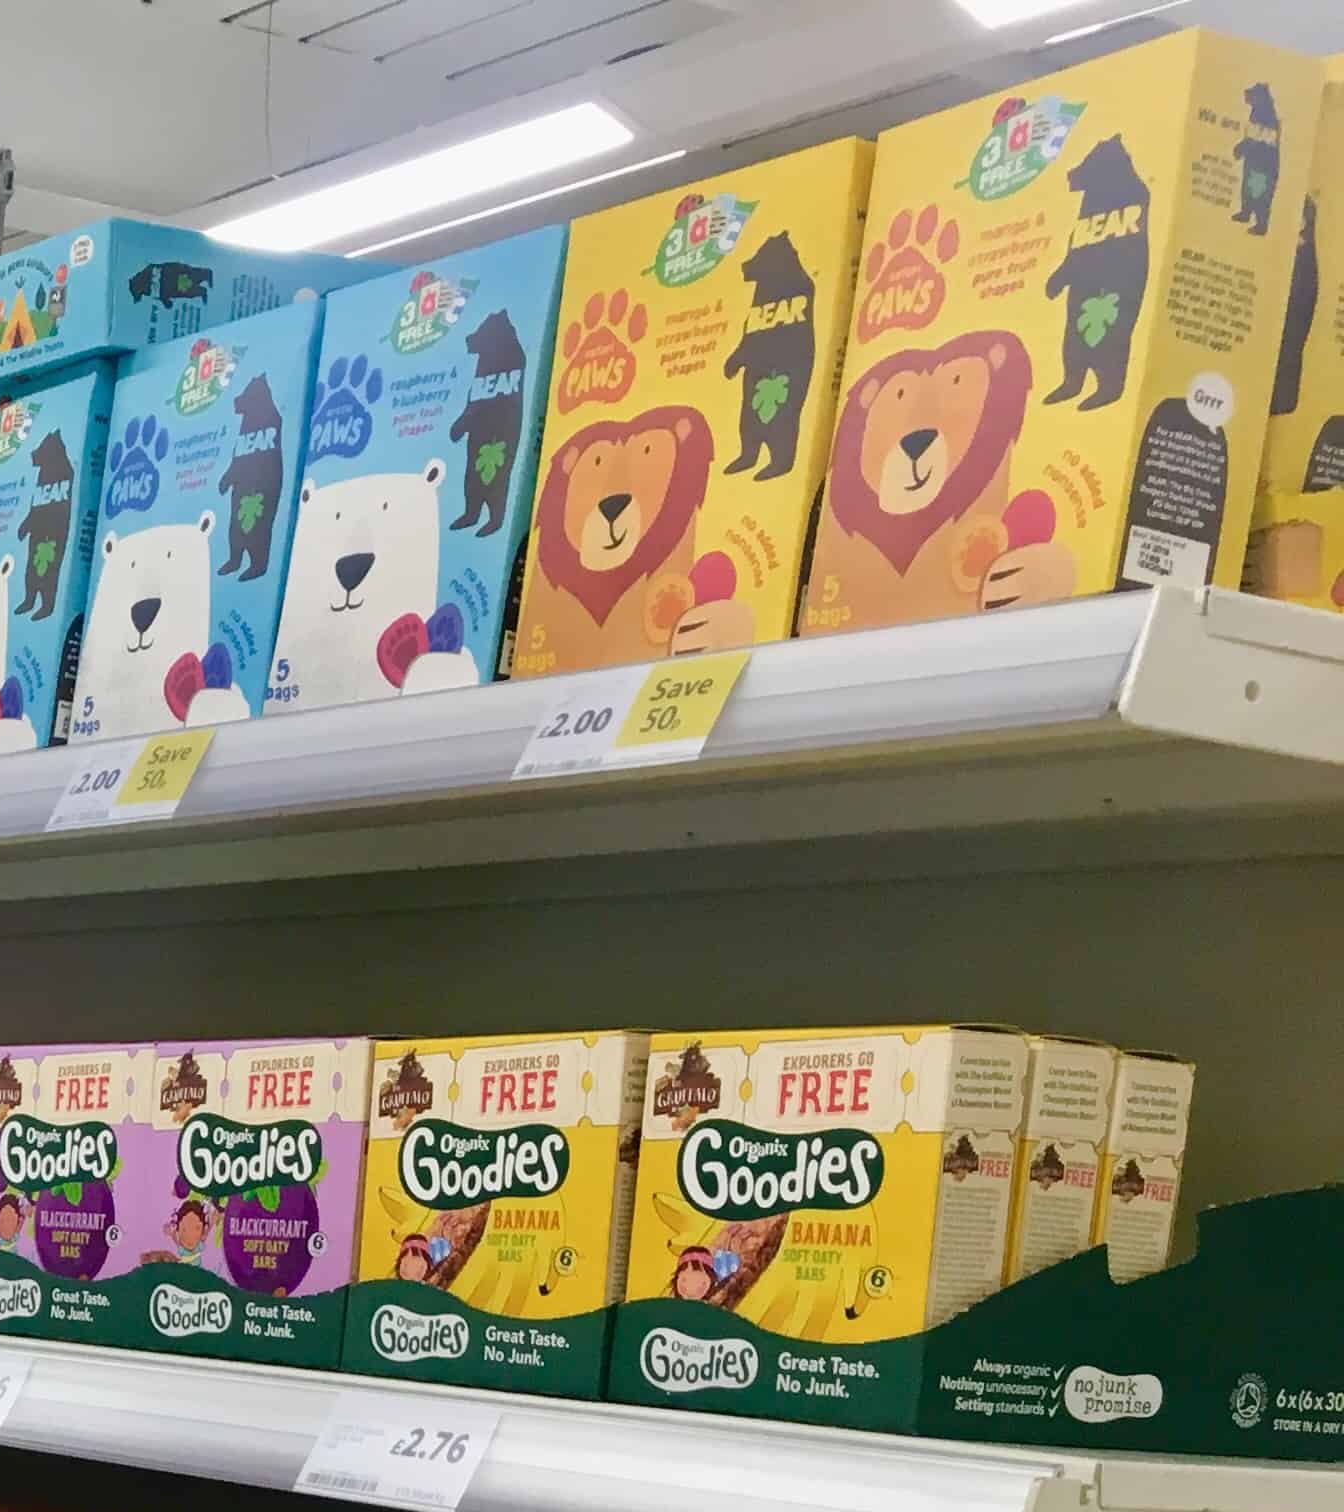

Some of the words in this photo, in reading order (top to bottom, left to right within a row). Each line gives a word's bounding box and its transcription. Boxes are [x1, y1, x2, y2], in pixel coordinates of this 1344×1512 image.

[982, 137, 1001, 168] 3
[1071, 204, 1142, 249] BEAR
[665, 229, 683, 257] 3
[400, 301, 416, 328] 3
[745, 295, 808, 334] BEAR
[866, 280, 934, 325] PAWS
[470, 369, 521, 402] BEAR
[566, 358, 626, 398] PAWS
[1194, 389, 1224, 410] Grrr
[233, 427, 276, 457] BEAR
[313, 417, 363, 452] PAWS
[1061, 449, 1081, 468] no
[31, 479, 70, 506] BEAR
[112, 472, 153, 506] PAWS
[823, 576, 840, 602] 5
[806, 606, 852, 627] bags
[531, 626, 545, 651] 5
[276, 658, 290, 682] 5
[266, 683, 300, 700] bags
[648, 675, 714, 701] Save
[82, 697, 94, 718] 5
[640, 705, 681, 733] 50p
[73, 718, 101, 737] bags
[147, 744, 193, 765] Save
[136, 770, 166, 792] 50p
[484, 1057, 542, 1074] EXPLORERS
[546, 1054, 560, 1068] GO
[783, 1052, 853, 1071] EXPLORERS
[858, 1051, 875, 1066] GO
[247, 1071, 313, 1110] FREE
[480, 1070, 558, 1115] FREE
[777, 1068, 873, 1118] FREE
[180, 1120, 317, 1188] Goodies
[729, 1136, 789, 1163] Organix
[402, 1126, 565, 1201] Goodies
[682, 1127, 878, 1210] Goodies
[229, 1216, 308, 1239] BLACKCURRANT
[493, 1209, 561, 1231] BANANA
[312, 1236, 324, 1251] 6
[791, 1222, 873, 1247] BANANA
[783, 1249, 810, 1264] SOFT
[812, 1250, 843, 1266] OATY
[795, 1265, 826, 1281] BARS
[870, 1269, 885, 1289] 6
[485, 1326, 524, 1344] Great
[529, 1329, 570, 1349] Taste.
[484, 1345, 505, 1362] No
[507, 1348, 545, 1367] Junk.
[778, 1351, 827, 1377] Great
[831, 1356, 880, 1379] Taste.
[973, 1358, 1013, 1378] Always
[1014, 1362, 1051, 1379] organic
[776, 1373, 801, 1394] No
[805, 1374, 850, 1398] Junk.
[939, 1376, 984, 1396] Nothing
[985, 1380, 1048, 1399] unnecessary
[1074, 1377, 1095, 1393] no
[1099, 1376, 1137, 1398] junk
[955, 1397, 993, 1416] Setting
[995, 1400, 1045, 1416] standards
[1083, 1394, 1152, 1416] promise
[389, 1428, 469, 1463] £2.76
